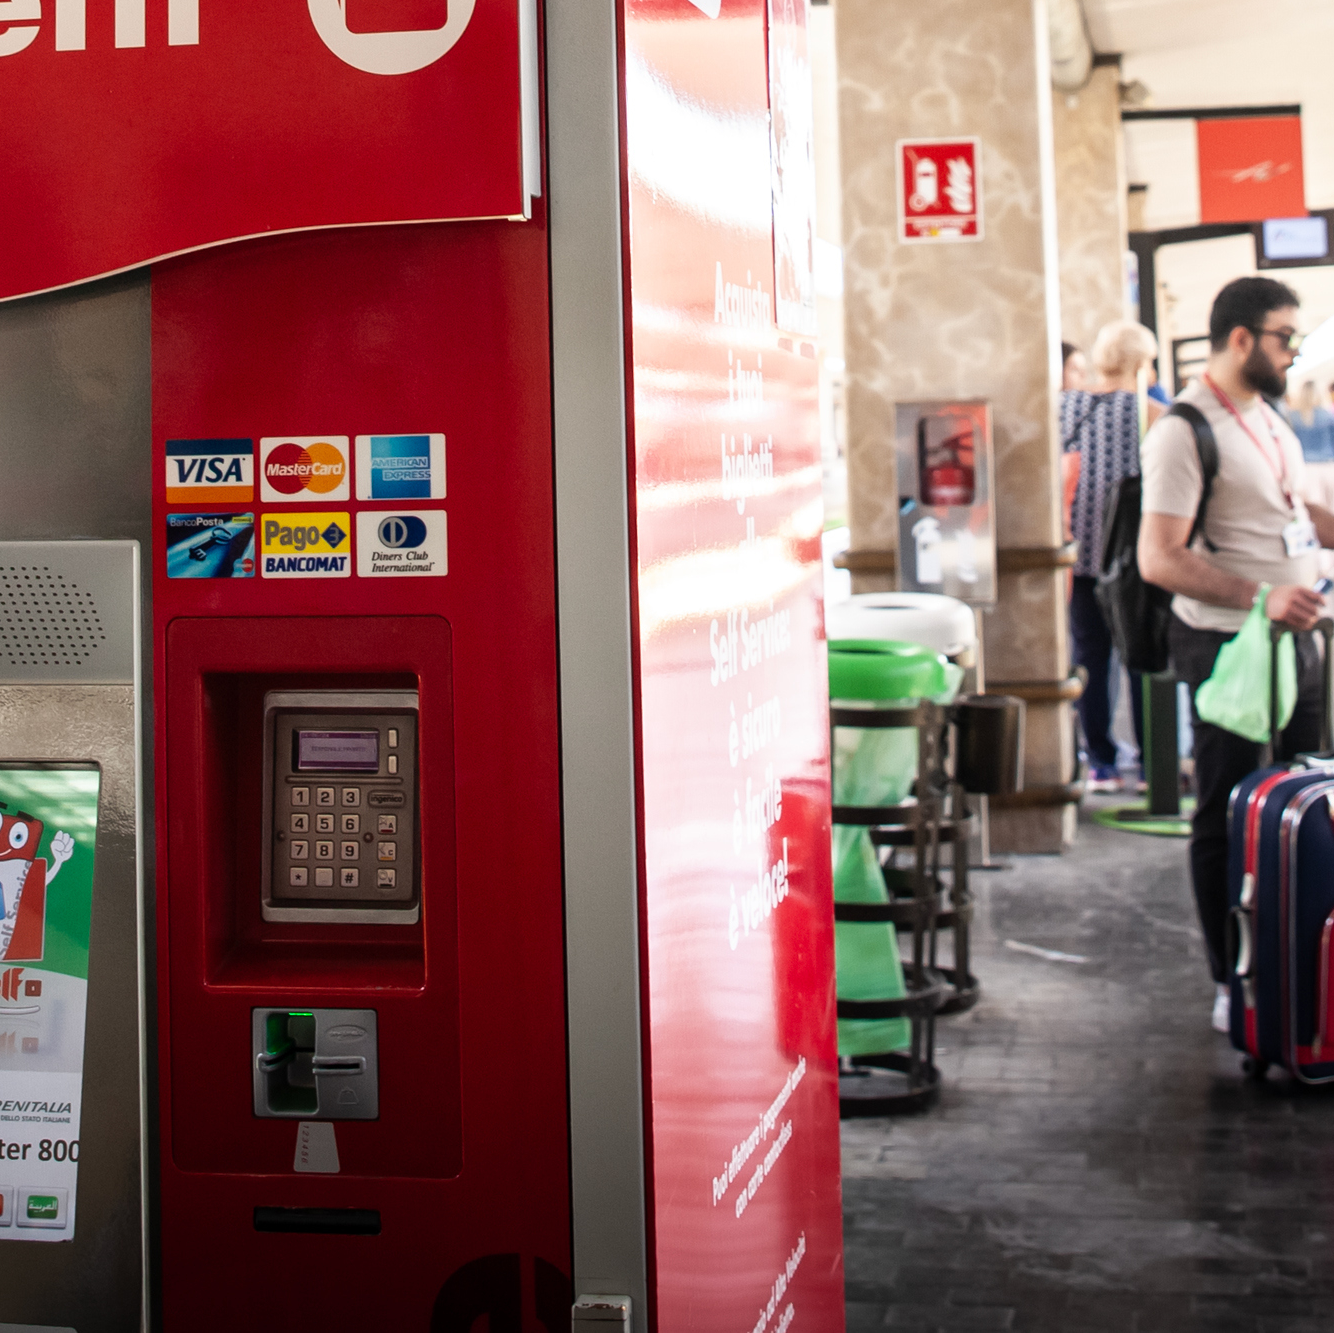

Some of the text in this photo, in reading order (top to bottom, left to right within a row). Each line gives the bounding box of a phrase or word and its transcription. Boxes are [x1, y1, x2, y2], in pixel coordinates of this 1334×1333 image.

[371, 456, 428, 469] AMERICAN
[174, 457, 245, 484] VISA
[266, 461, 344, 479] MasterCard
[383, 469, 432, 481] EXPRESS
[721, 432, 773, 515] biglietti
[170, 516, 224, 527] BancoPosta
[264, 521, 320, 551] Pago
[371, 550, 429, 562] Diners Club
[265, 556, 348, 573] BANCOMAT
[371, 561, 434, 573] International
[709, 594, 791, 687] Self Service:
[728, 691, 781, 768] è sicuro
[296, 791, 304, 803] 1
[320, 791, 331, 803] 2
[345, 791, 356, 803] 3
[370, 794, 403, 806] ingenico
[745, 762, 782, 845] facile
[294, 818, 305, 829] 4
[319, 818, 330, 830] 5
[345, 818, 355, 830] 6
[294, 845, 304, 856] 7
[319, 844, 330, 856] 8
[345, 845, 355, 857] 9
[728, 837, 789, 951] è veloce!
[21, 1115, 41, 1123] STATO
[42, 1116, 71, 1124] ITALIANE
[300, 1124, 310, 1164] 123456
[38, 1139, 81, 1162] 800
